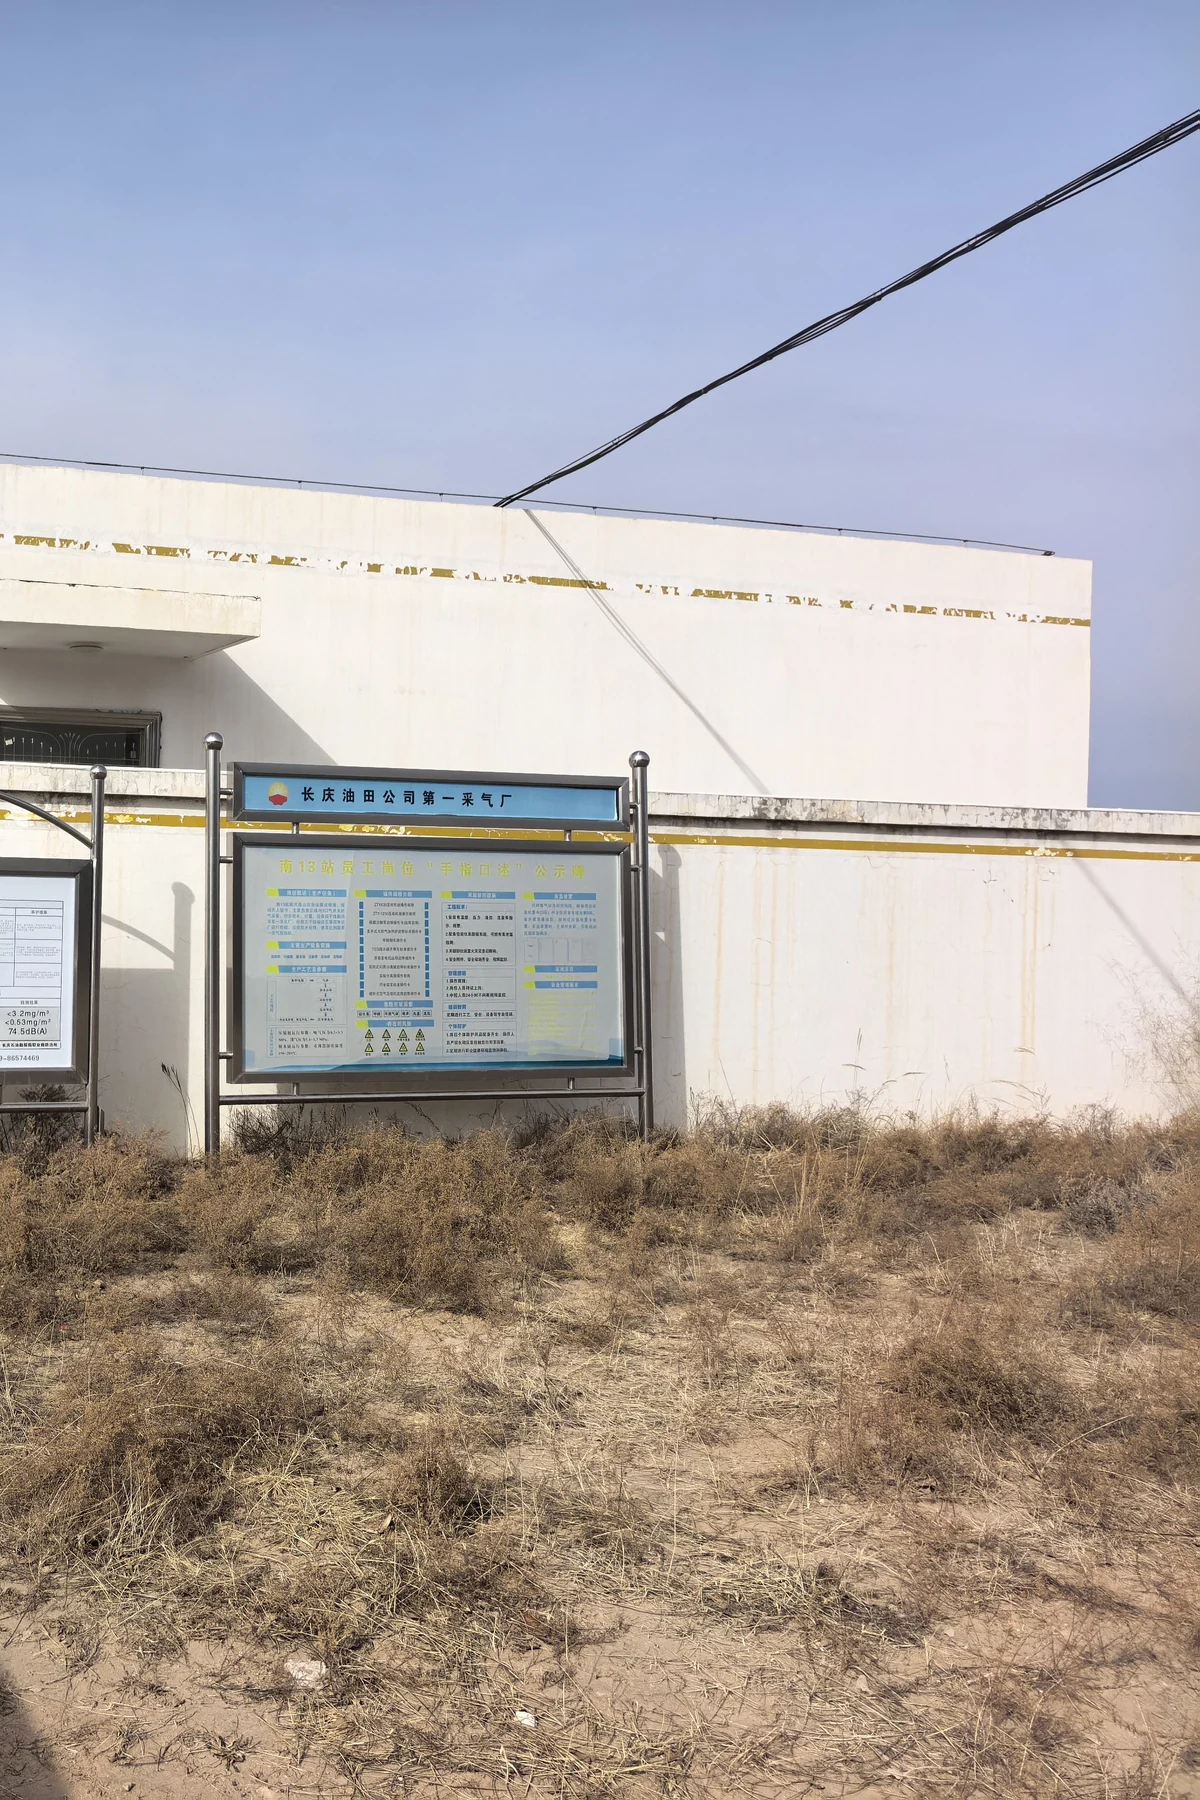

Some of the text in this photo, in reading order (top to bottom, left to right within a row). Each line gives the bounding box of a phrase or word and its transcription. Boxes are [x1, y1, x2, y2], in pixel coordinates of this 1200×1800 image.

[301, 786, 513, 808] 长庆油田公司第一采气厂
